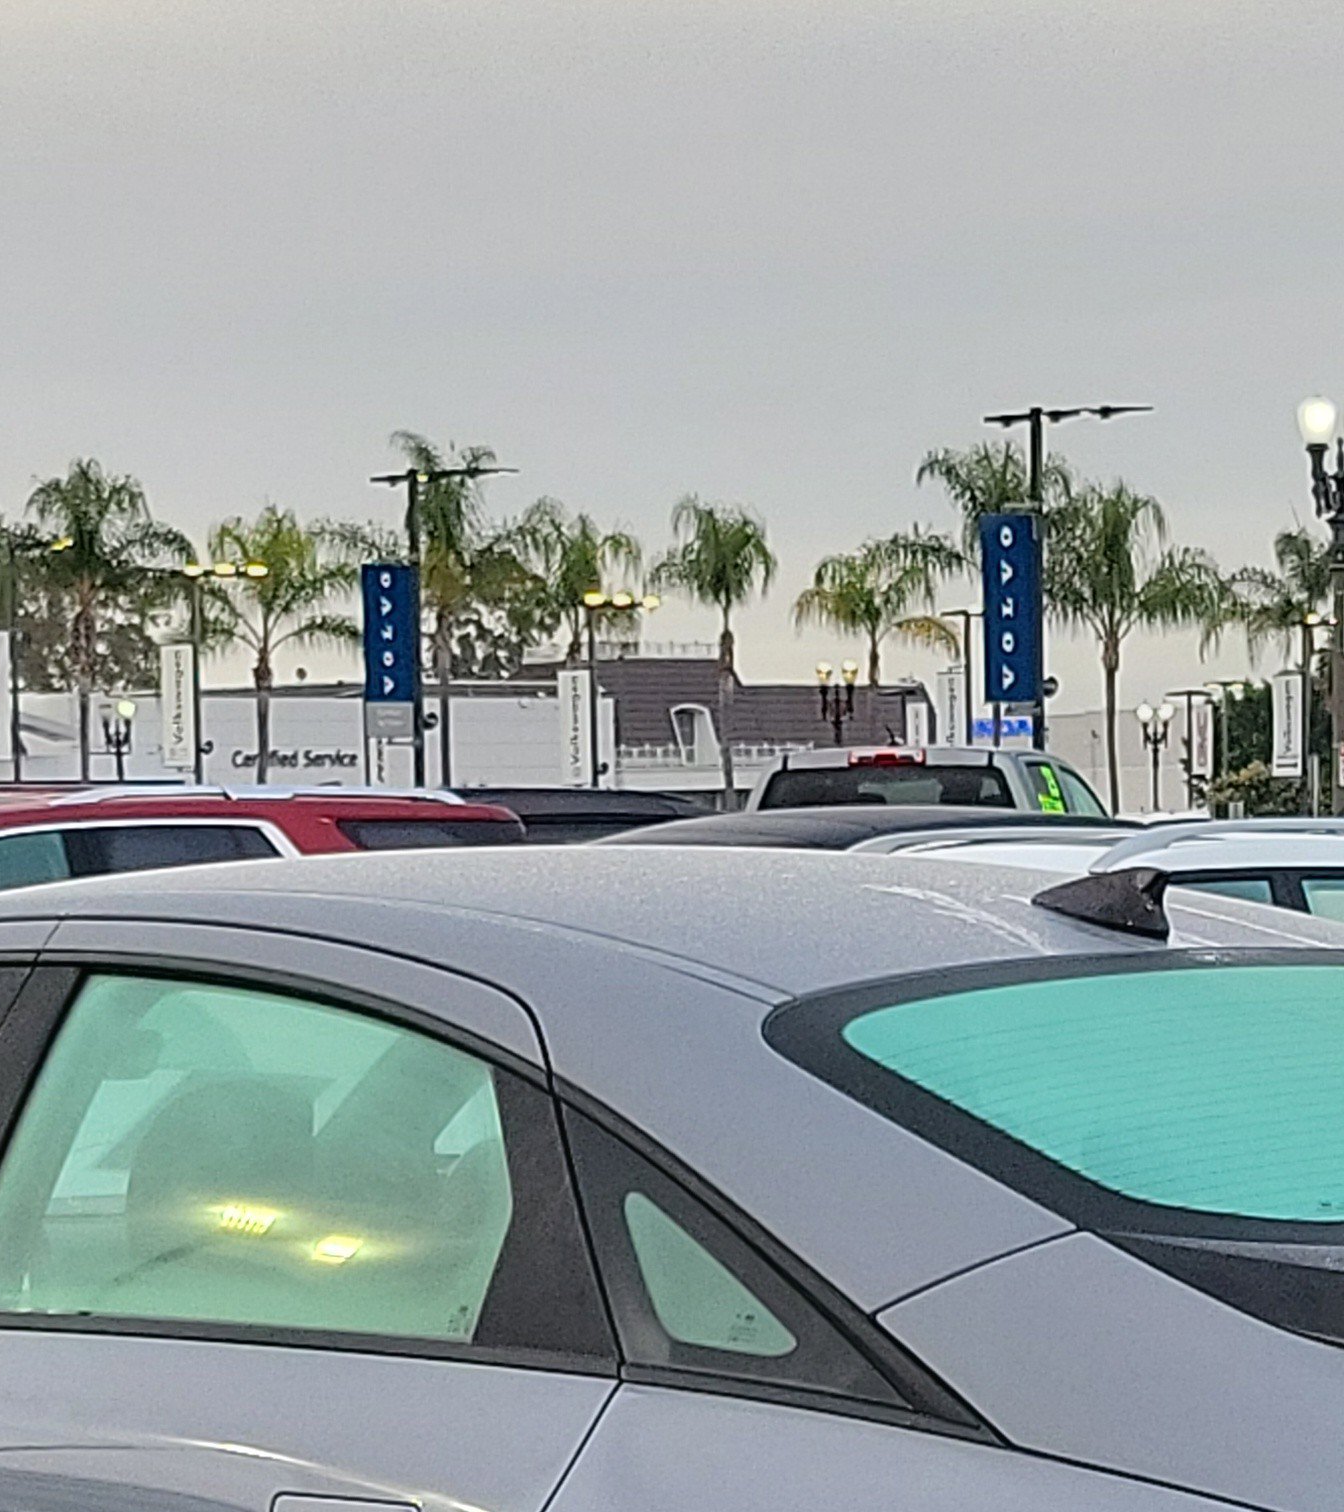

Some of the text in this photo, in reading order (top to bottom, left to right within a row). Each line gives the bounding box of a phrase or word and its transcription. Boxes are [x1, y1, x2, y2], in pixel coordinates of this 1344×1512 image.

[380, 571, 395, 695] VOLVO
[999, 525, 1015, 691] VOLVO
[231, 749, 299, 768] Cerfied
[302, 748, 359, 768] Service
